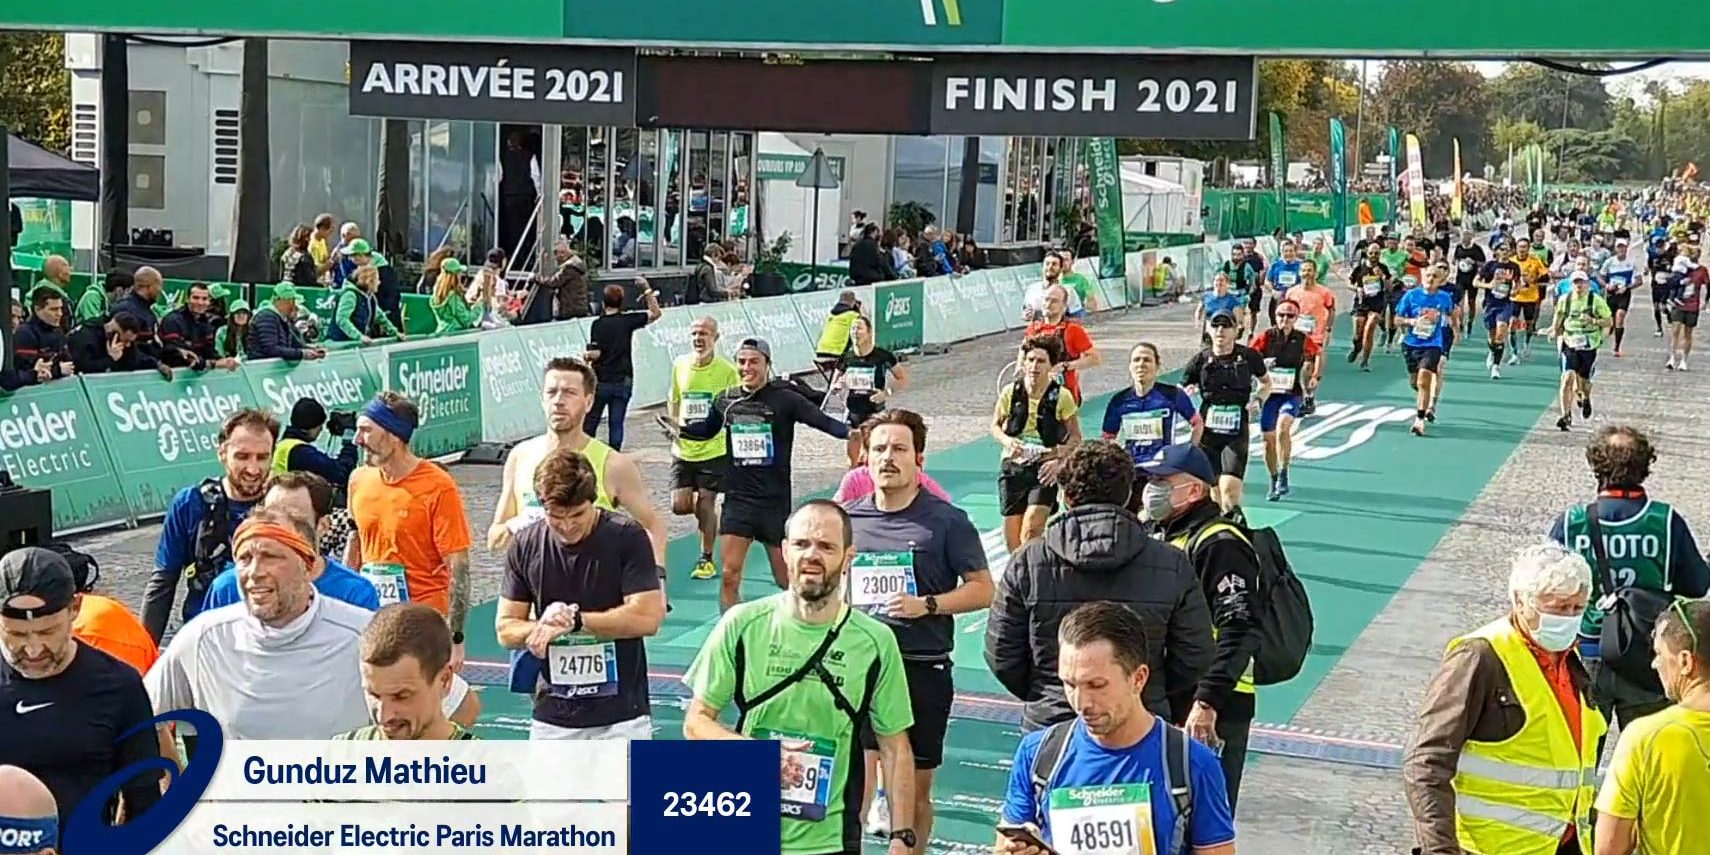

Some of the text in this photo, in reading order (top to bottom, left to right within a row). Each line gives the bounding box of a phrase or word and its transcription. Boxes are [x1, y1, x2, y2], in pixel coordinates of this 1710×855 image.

[362, 59, 623, 103] ARRIVÉE 2021
[945, 77, 1237, 113] FINISH 2021
[262, 370, 365, 414] Schneider
[399, 355, 470, 398] Schneider
[107, 385, 242, 433] Schneider
[430, 394, 469, 419] Electric
[180, 429, 219, 455] Elec
[4, 447, 93, 481] Electric
[863, 575, 905, 595] 23007
[559, 654, 604, 676] 24776
[1068, 786, 1126, 800] Schneider
[0, 828, 43, 847] ORT
[1070, 819, 1134, 851] 48591
